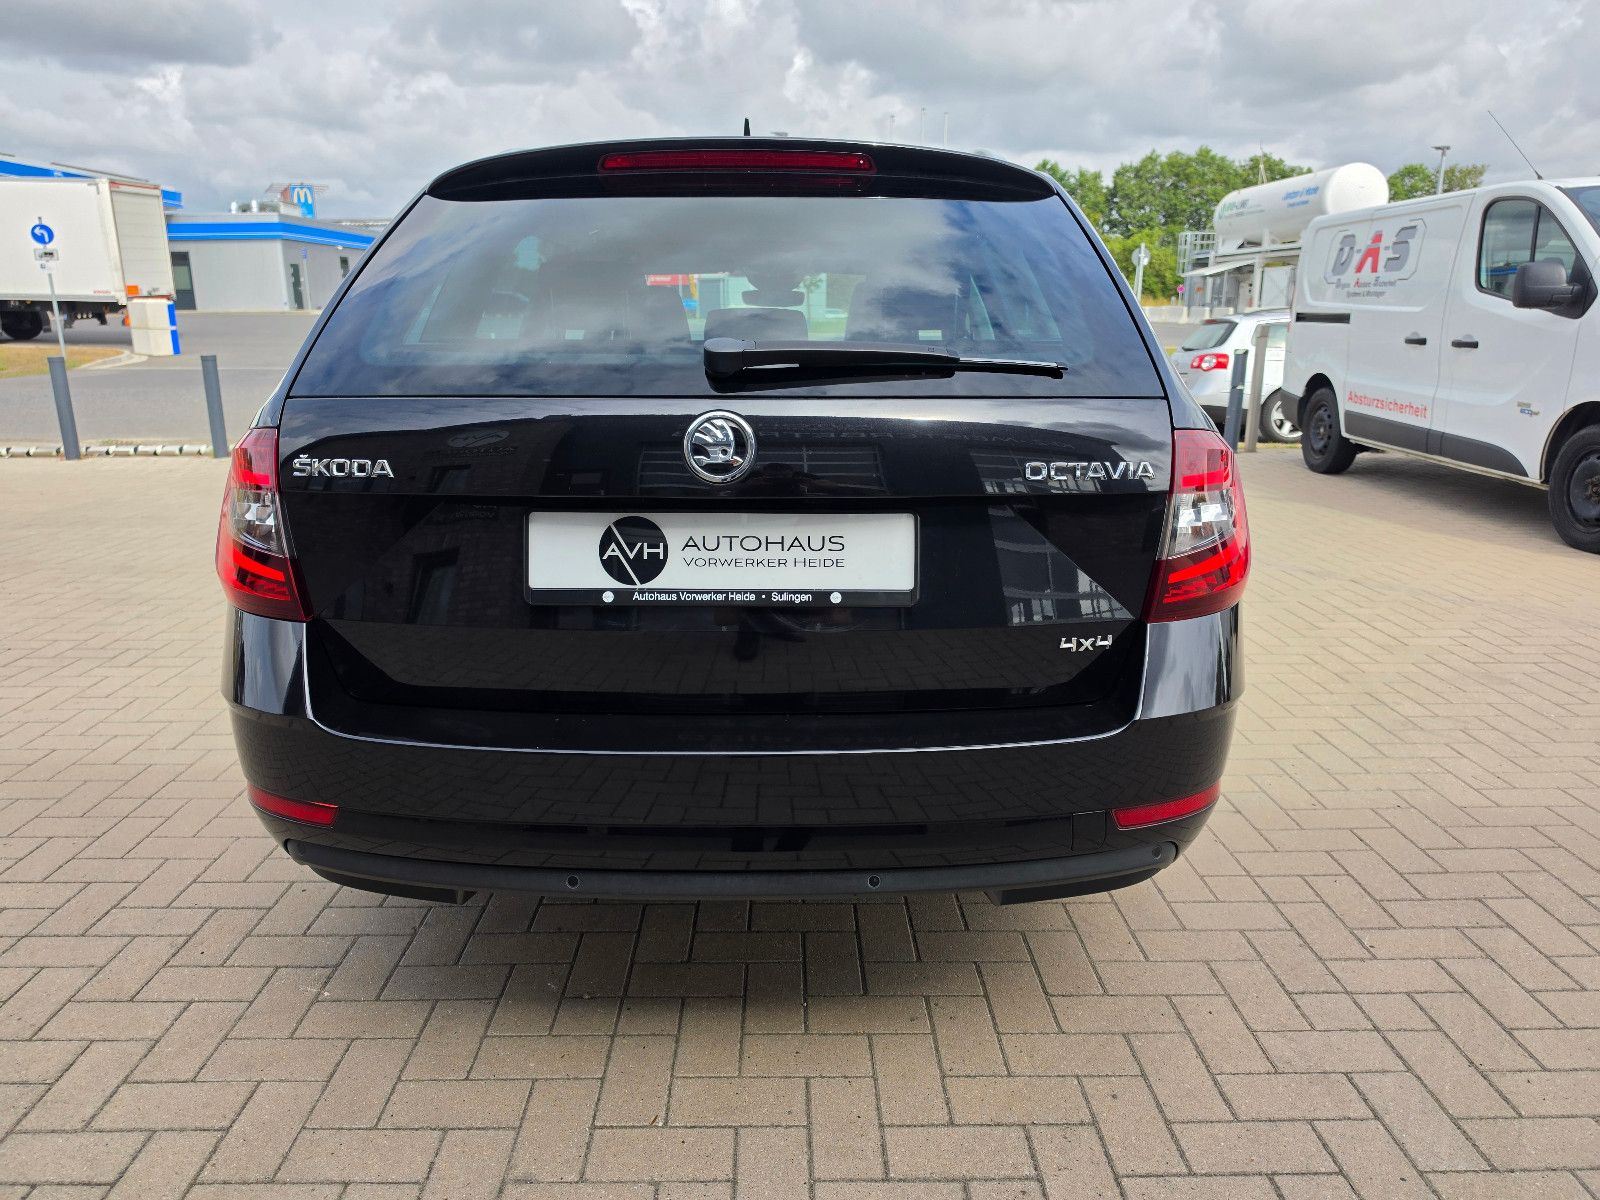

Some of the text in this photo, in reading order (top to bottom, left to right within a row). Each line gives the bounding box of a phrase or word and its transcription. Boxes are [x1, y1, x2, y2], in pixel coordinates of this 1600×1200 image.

[1347, 391, 1427, 418] Absturzsicherheit
[292, 454, 394, 478] ŠKODA
[1025, 461, 1156, 481] OCTAVIA
[681, 535, 845, 552] AUTOHAUS
[683, 557, 845, 568] VORWERKER HEIDE
[632, 592, 812, 603] Autohaus Vorwerker Heide Sulingen
[1059, 634, 1113, 653] 4x4
